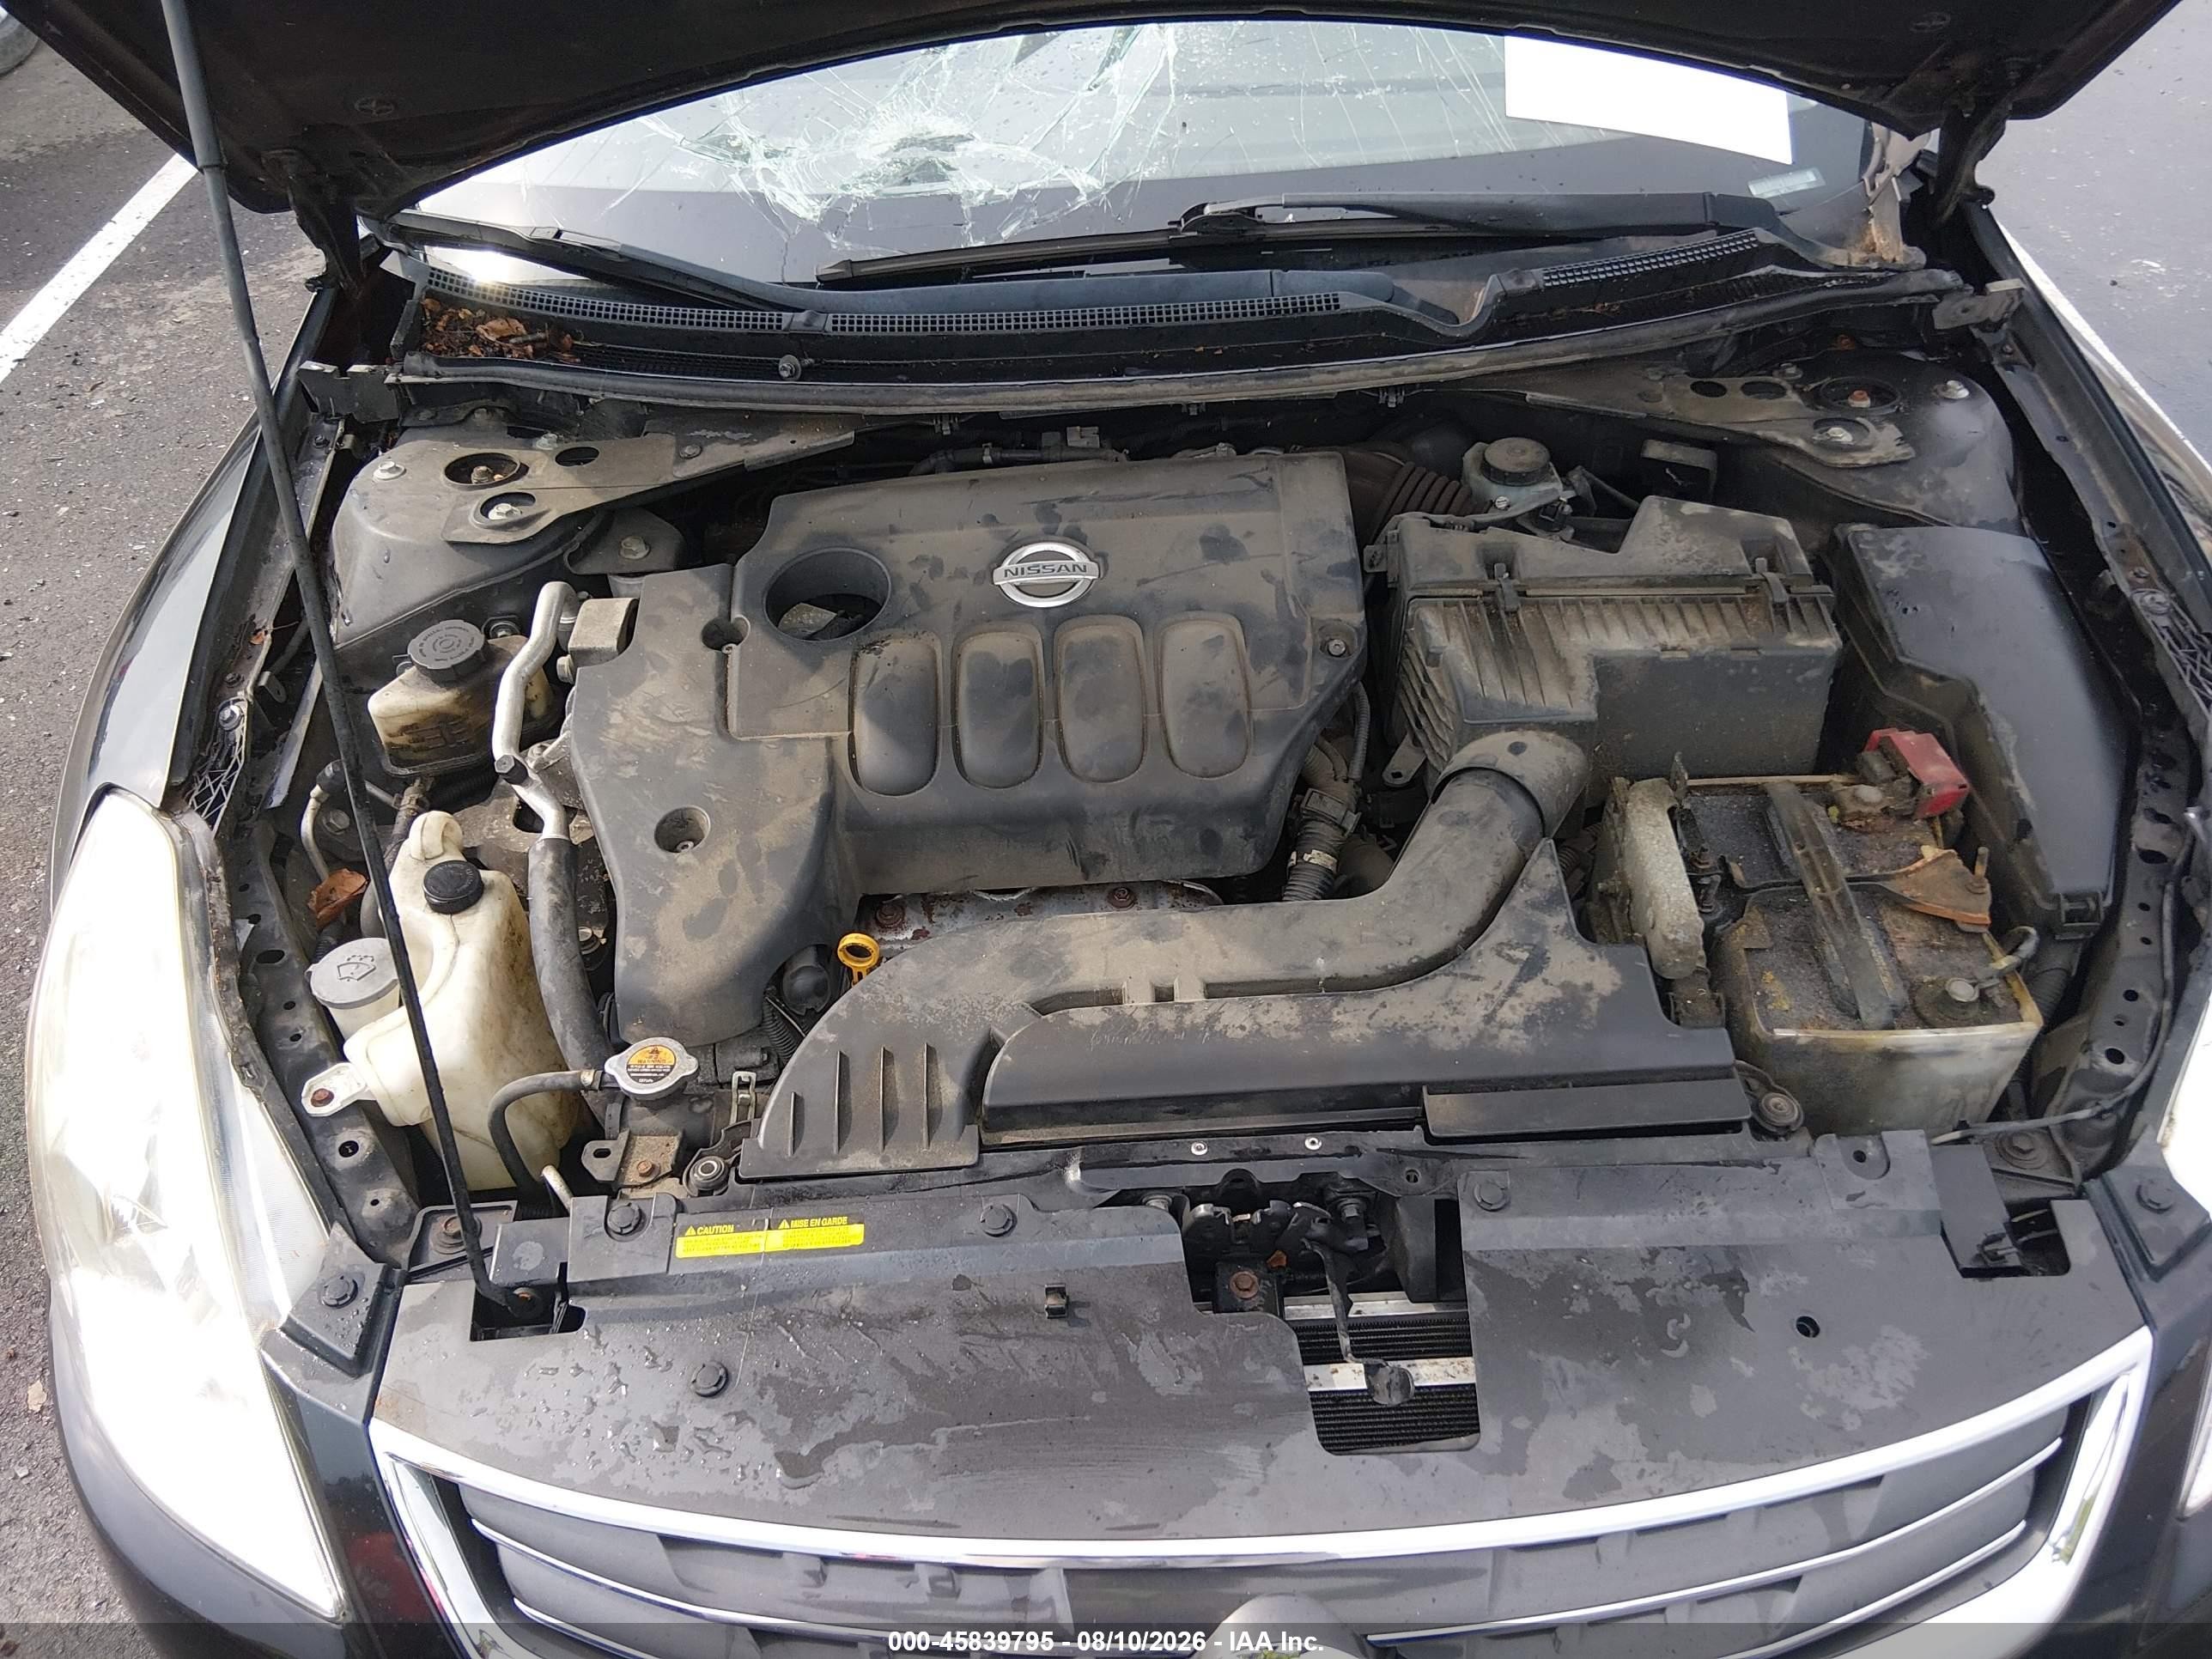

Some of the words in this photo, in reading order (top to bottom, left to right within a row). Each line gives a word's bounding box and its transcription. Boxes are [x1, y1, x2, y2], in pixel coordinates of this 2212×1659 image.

[1004, 564, 1086, 577] NISSAN
[790, 1218, 809, 1229] MISE
[810, 1218, 821, 1226] EN
[822, 1216, 848, 1226] GARDE
[696, 1224, 734, 1235] CAUTION
